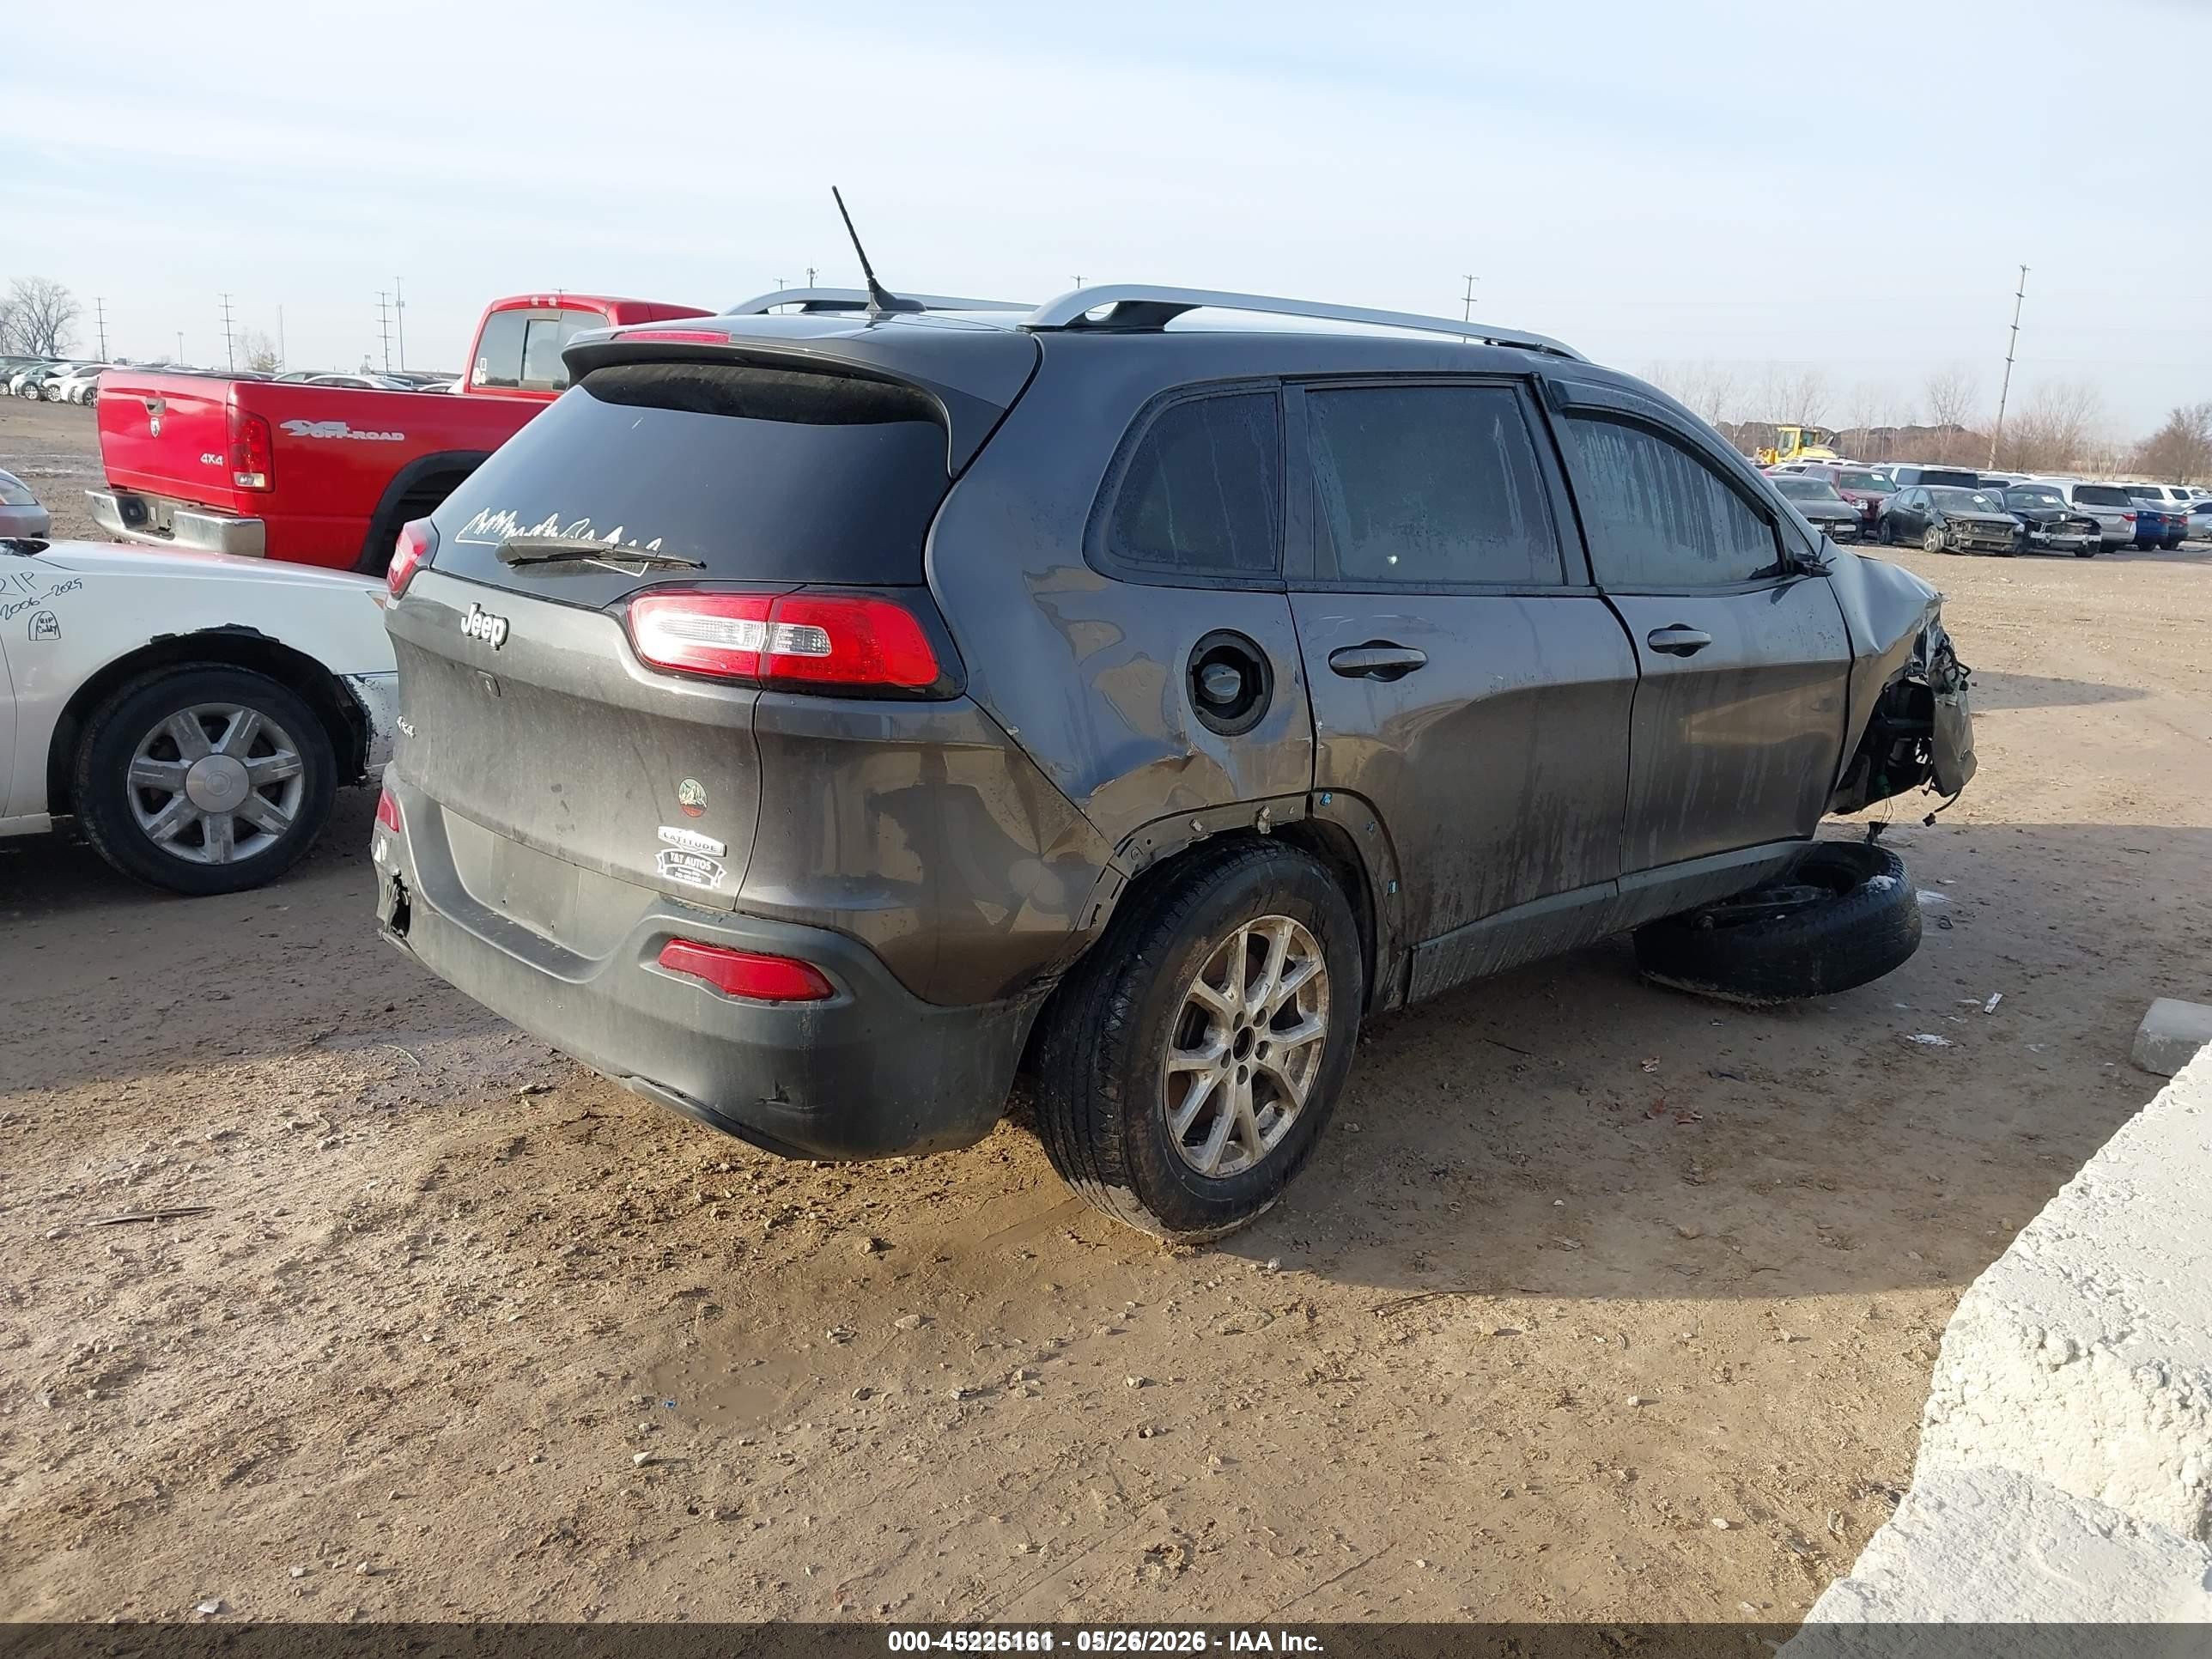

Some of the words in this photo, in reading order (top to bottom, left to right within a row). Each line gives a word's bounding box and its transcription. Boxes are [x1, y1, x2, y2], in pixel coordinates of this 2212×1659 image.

[460, 602, 509, 651] Jeep
[663, 831, 718, 852] LATITUDE
[670, 852, 684, 864] T&T
[684, 856, 711, 871] AUTOS
